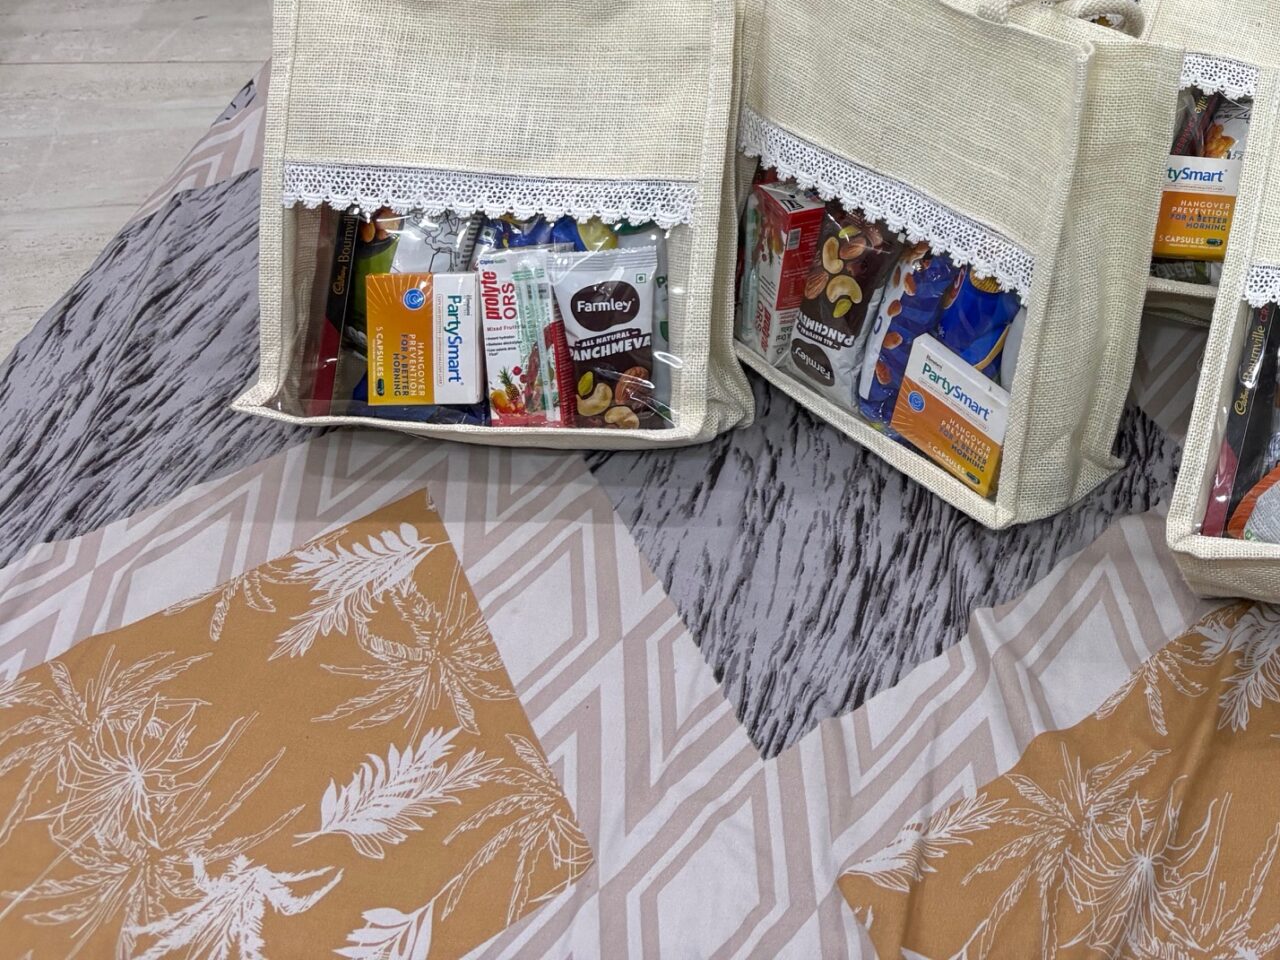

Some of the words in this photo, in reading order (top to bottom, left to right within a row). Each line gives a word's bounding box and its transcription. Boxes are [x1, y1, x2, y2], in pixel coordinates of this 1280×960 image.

[1171, 206, 1229, 216] PREVENTION
[1180, 199, 1231, 210] HANGOVER
[1197, 215, 1227, 224] BETTER
[338, 214, 356, 263] Bournvill
[1165, 235, 1204, 244] CAPSULES
[1185, 222, 1226, 232] MORNING
[481, 271, 502, 320] prolyte
[502, 283, 517, 320] ORS
[577, 298, 632, 313] Farmley
[376, 334, 384, 376] CAPSULES
[444, 295, 463, 383] PartySmart
[581, 340, 595, 348] ALL
[595, 330, 630, 344] NATURAL
[823, 340, 834, 348] ALL
[393, 353, 401, 396] MORNING
[401, 363, 409, 396] BETTER
[409, 334, 417, 396] PREVENTION
[794, 347, 831, 380] Farmley
[922, 362, 989, 421] PartySmart
[941, 419, 990, 460] PREVENTION
[949, 418, 991, 452] HANGOVER
[932, 446, 966, 474] CAPSULES
[951, 444, 985, 472] MORNING
